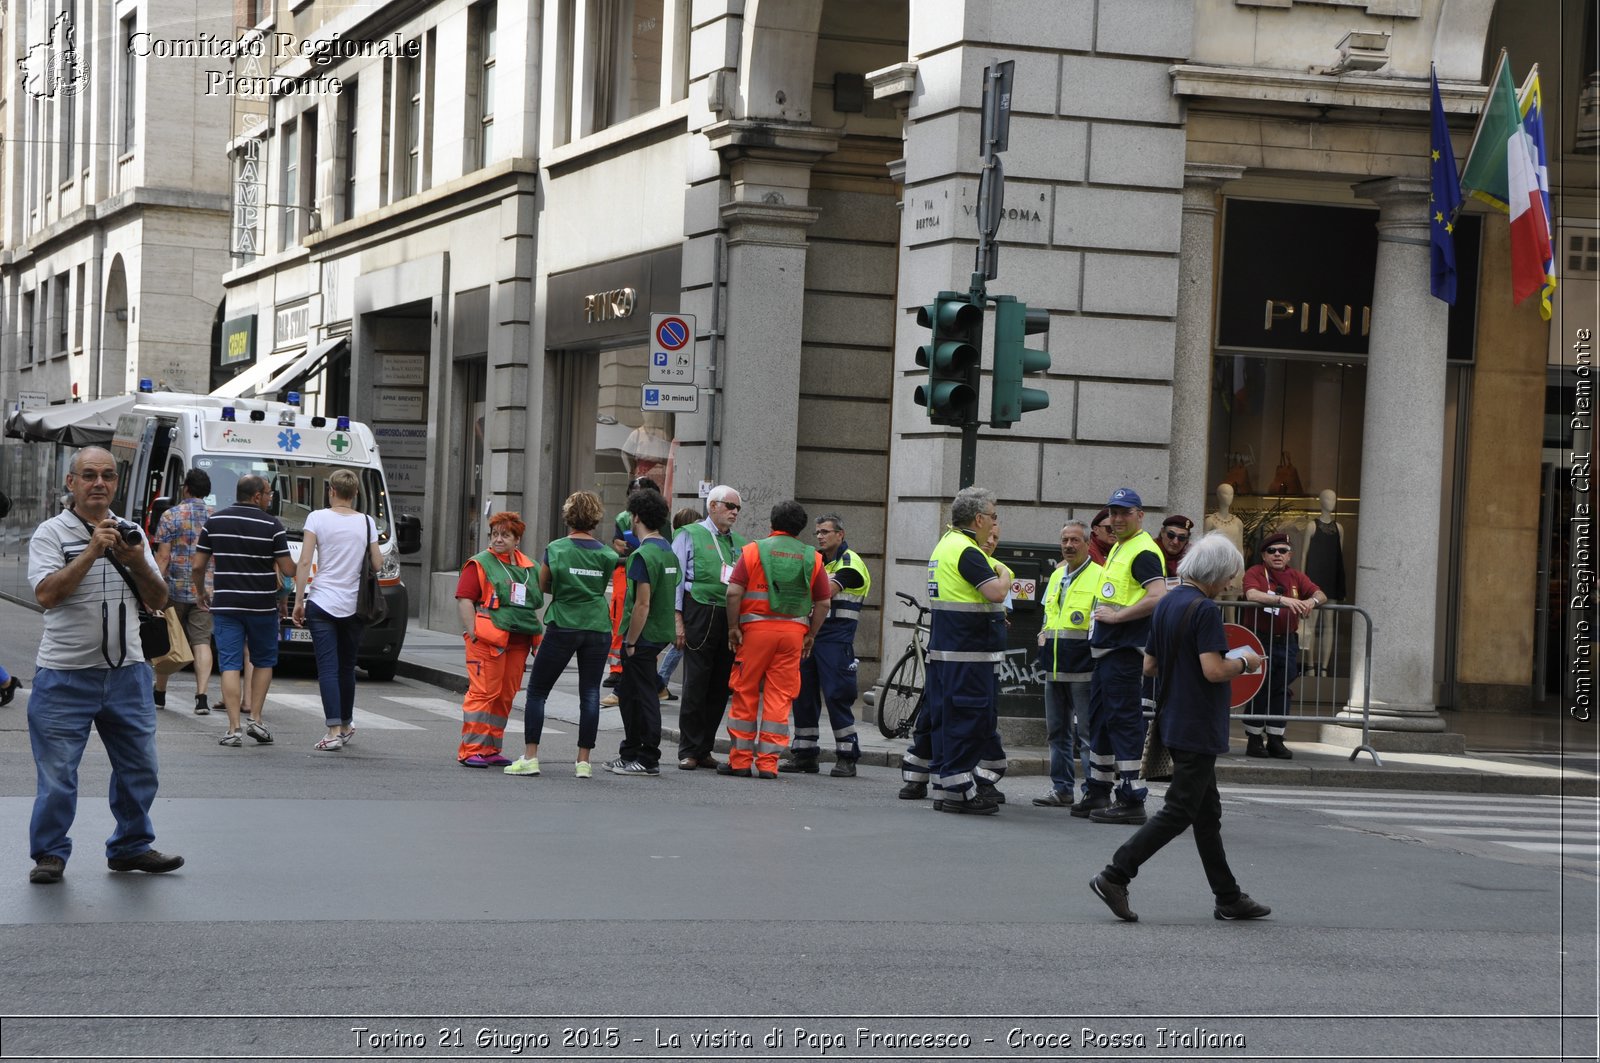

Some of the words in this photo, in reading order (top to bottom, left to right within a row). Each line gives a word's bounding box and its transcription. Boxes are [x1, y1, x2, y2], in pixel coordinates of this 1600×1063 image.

[924, 200, 934, 211] VIA
[916, 216, 940, 230] BERTOLA
[671, 394, 694, 402] minuti
